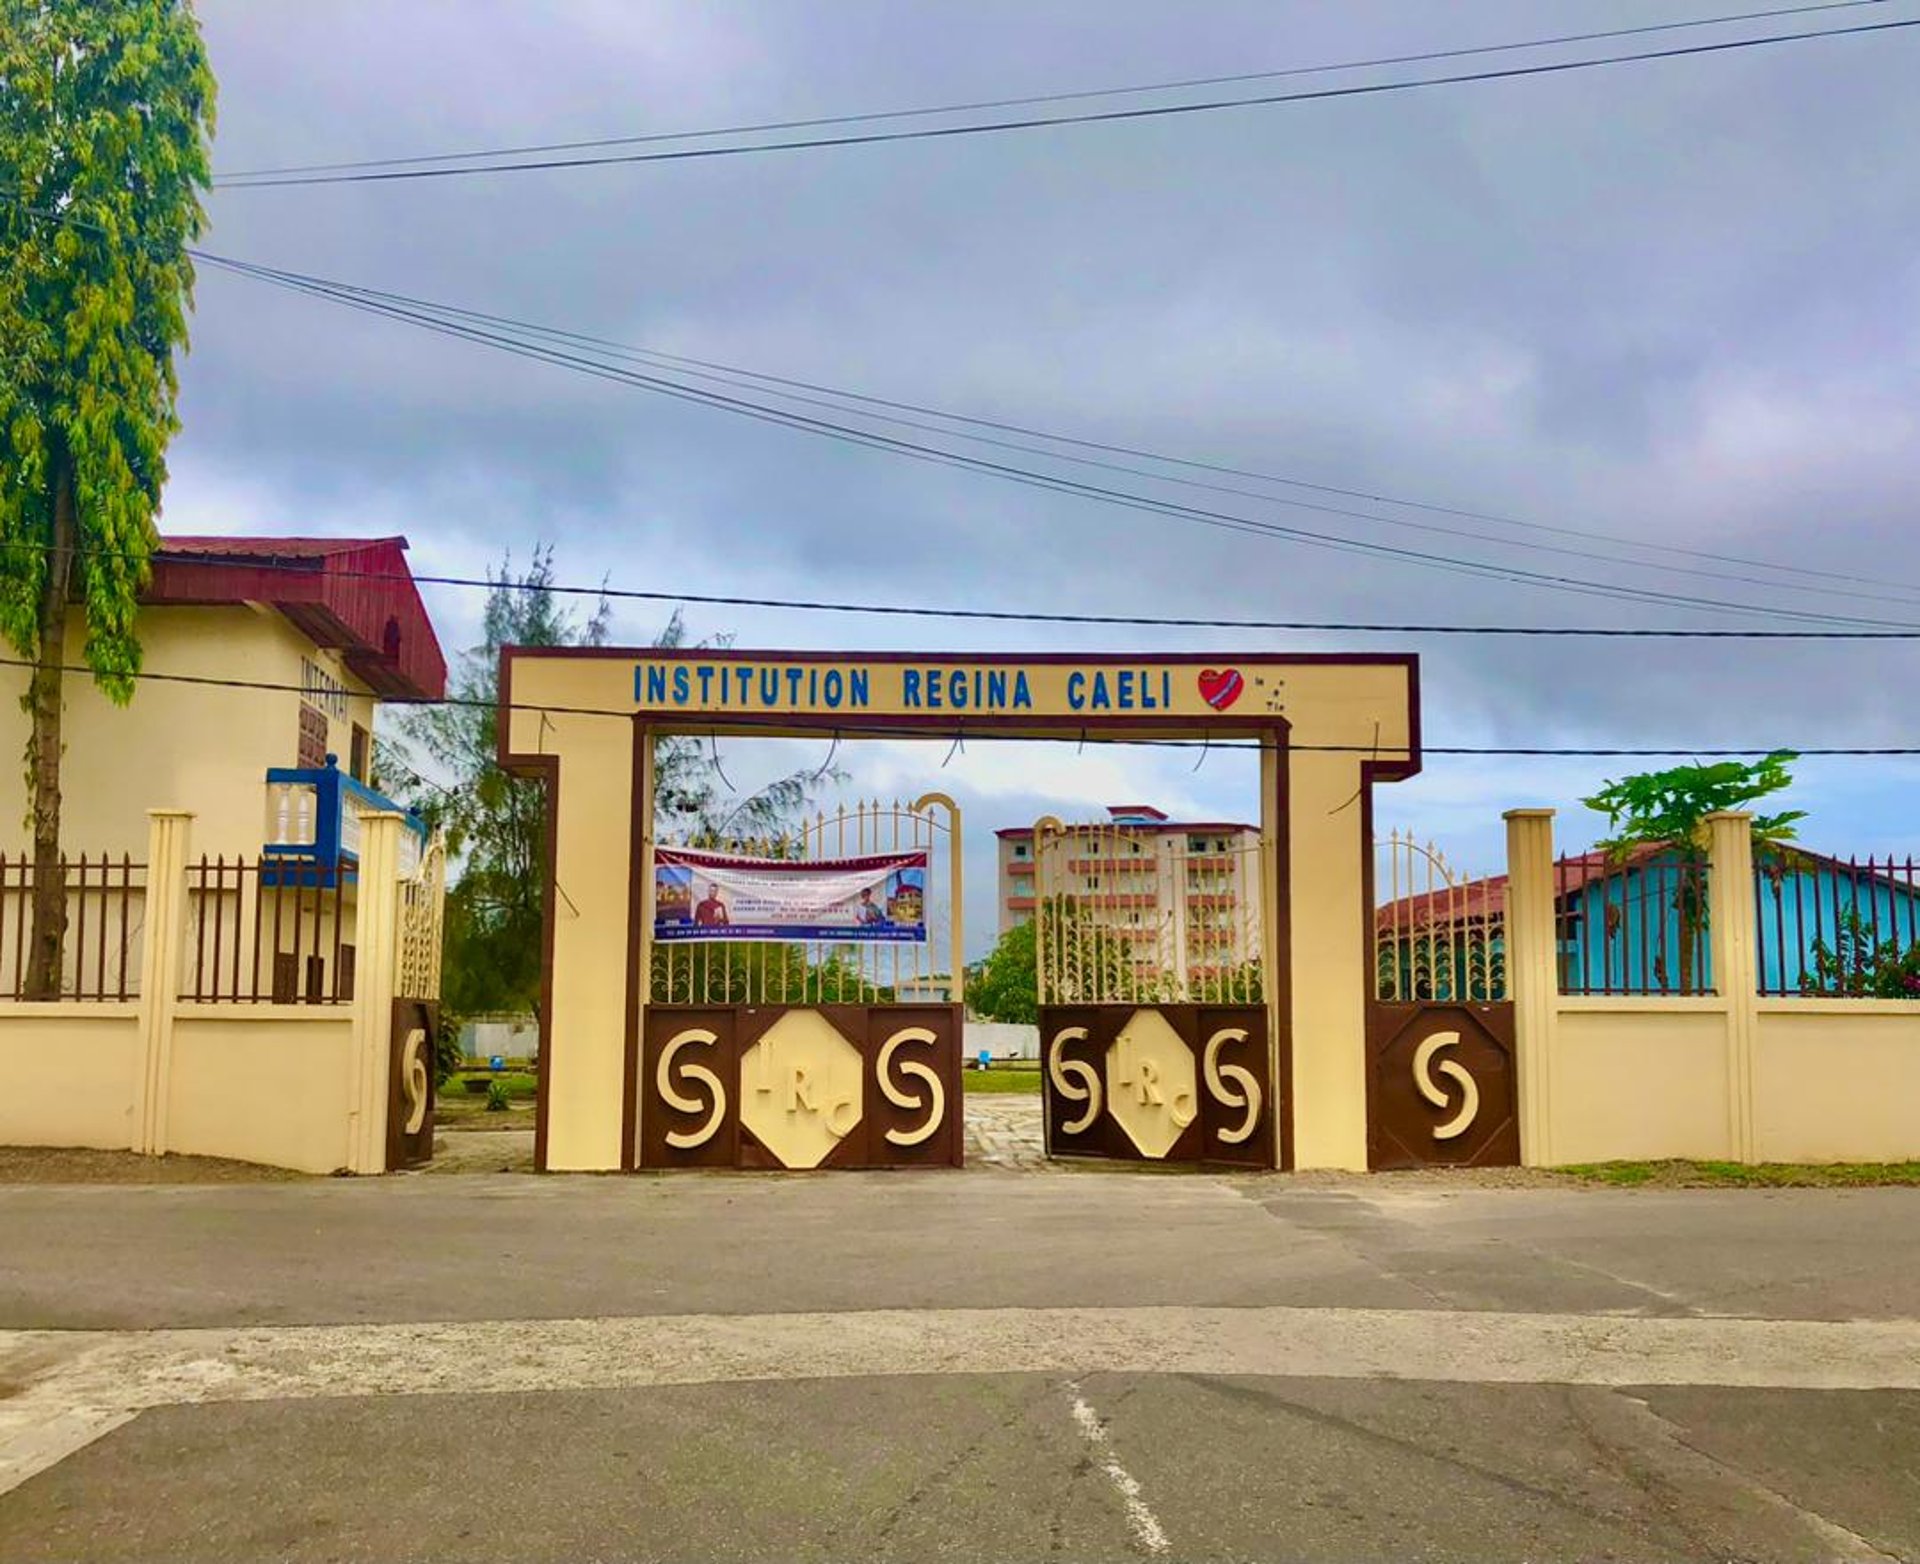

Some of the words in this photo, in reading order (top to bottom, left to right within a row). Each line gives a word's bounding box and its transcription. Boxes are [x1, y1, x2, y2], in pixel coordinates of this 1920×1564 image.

[634, 665, 869, 707] INSTITUTION
[904, 669, 1032, 708] REGINA
[1067, 671, 1170, 709] CAELI
